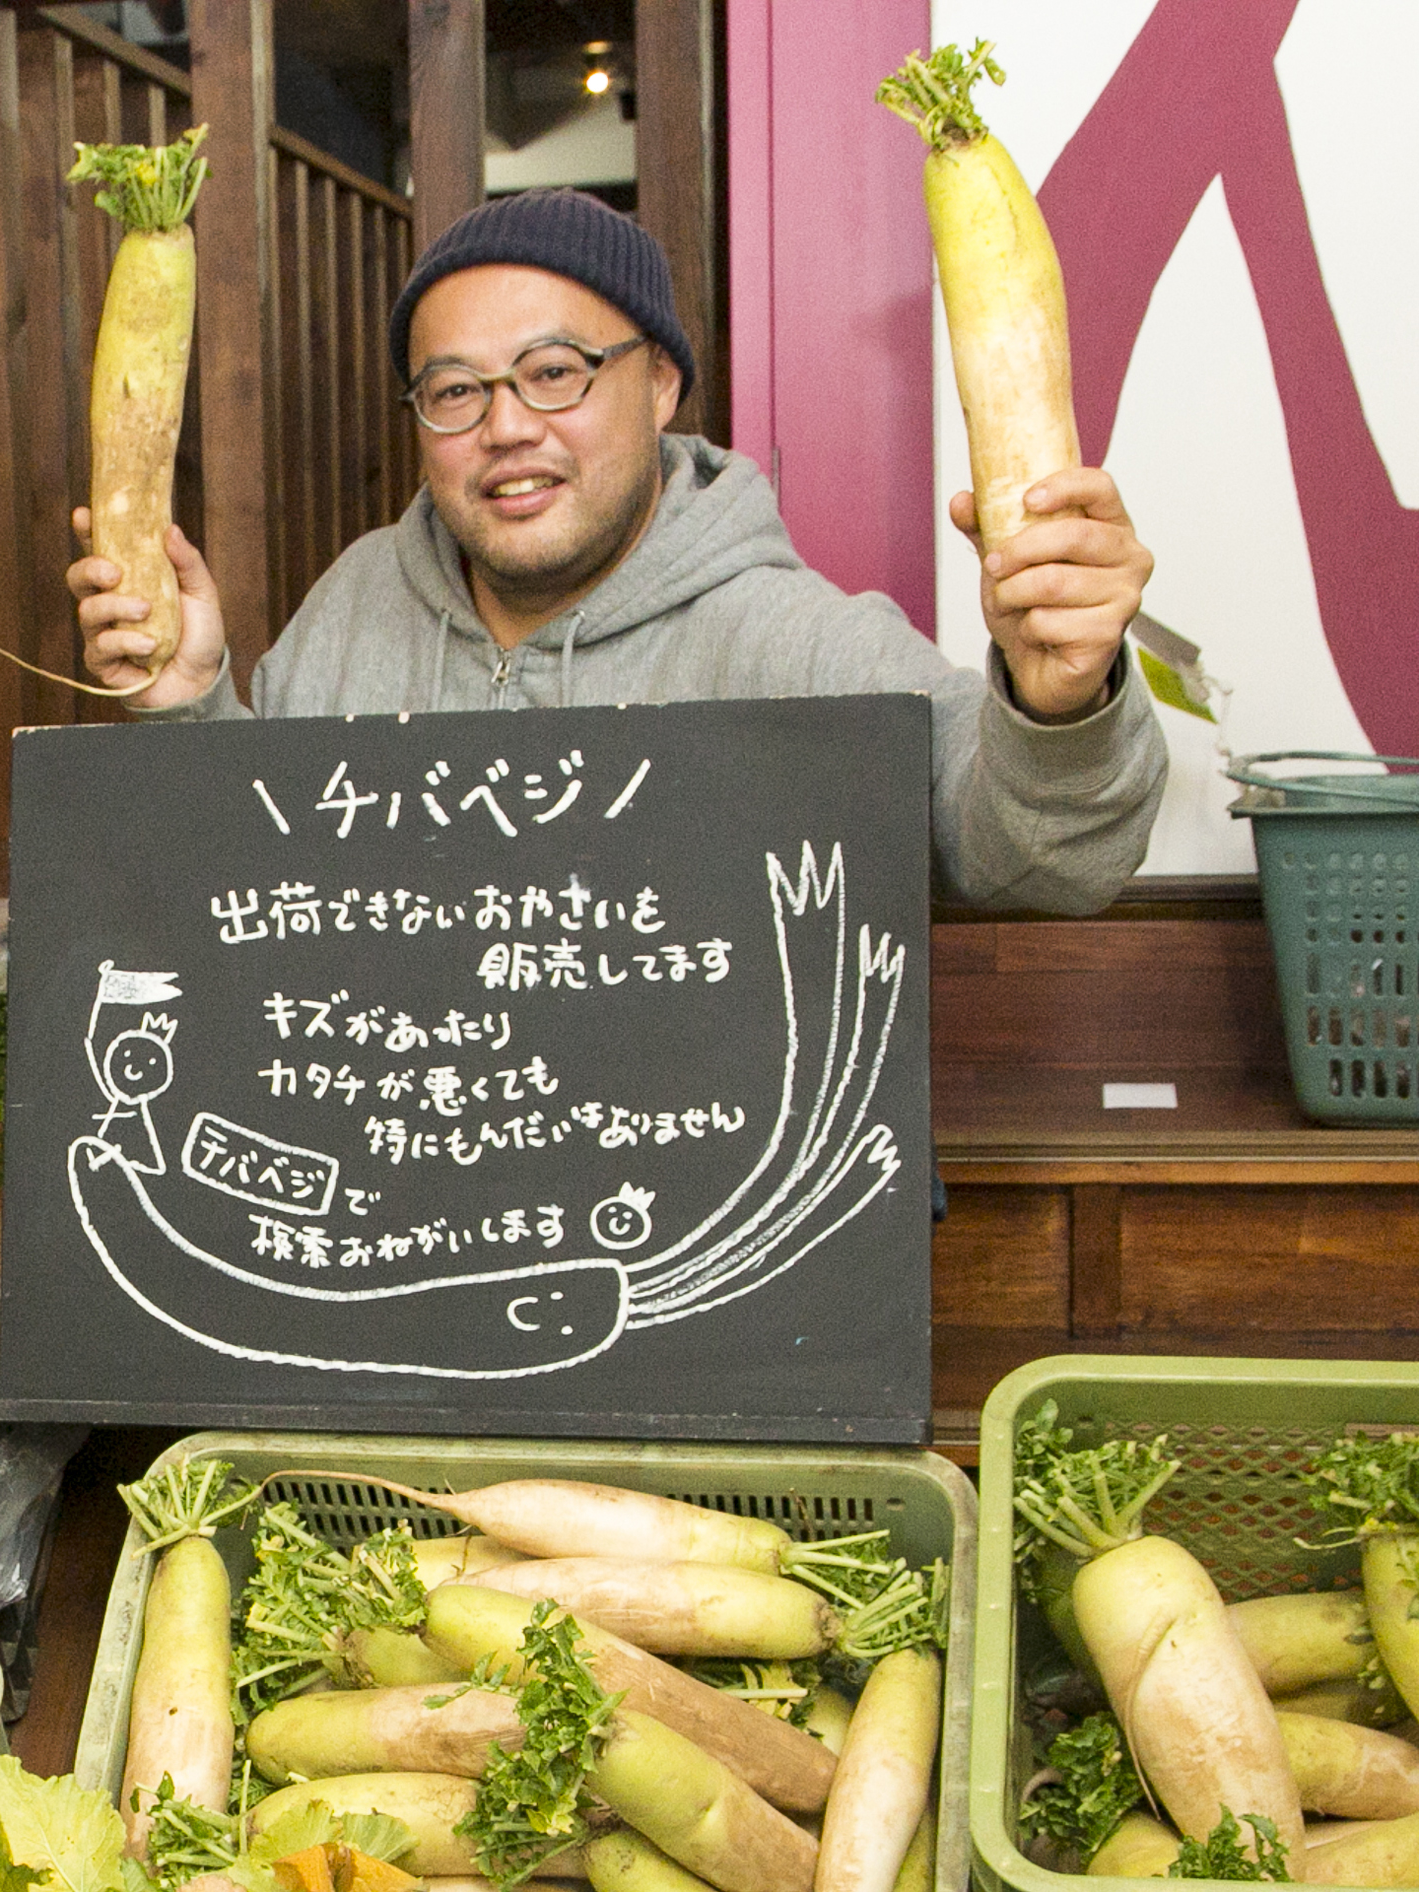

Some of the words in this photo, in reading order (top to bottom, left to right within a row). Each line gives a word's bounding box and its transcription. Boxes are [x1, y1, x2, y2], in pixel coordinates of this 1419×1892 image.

[476, 937, 733, 991] 販売してます
[262, 988, 512, 1052] キズがあったり
